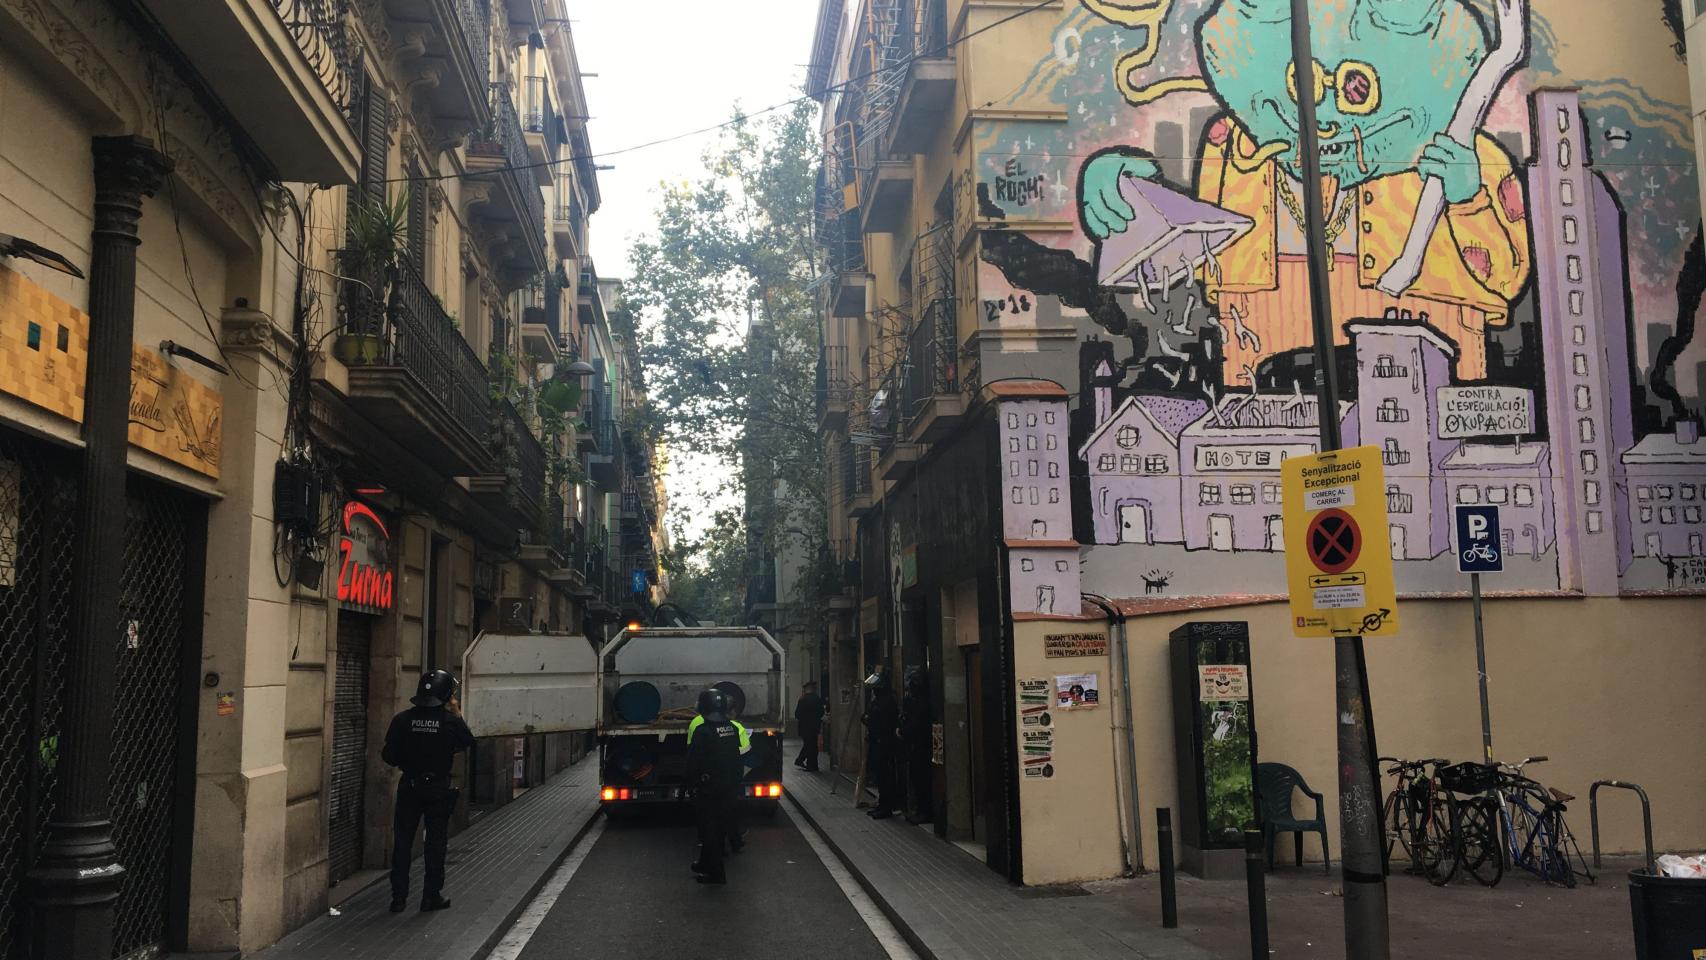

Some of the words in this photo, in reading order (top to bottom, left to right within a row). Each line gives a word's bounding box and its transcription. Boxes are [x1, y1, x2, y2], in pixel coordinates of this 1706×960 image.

[1458, 389, 1502, 400] CONTRA
[1301, 460, 1361, 478] Senyalització
[1304, 472, 1360, 489] Excepcional
[1311, 489, 1336, 499] COMERÇ
[1337, 488, 1346, 496] AL
[1316, 498, 1341, 506] CARRER
[1468, 514, 1488, 539] P
[337, 538, 393, 609] Zurna
[411, 719, 439, 728] POLICIA
